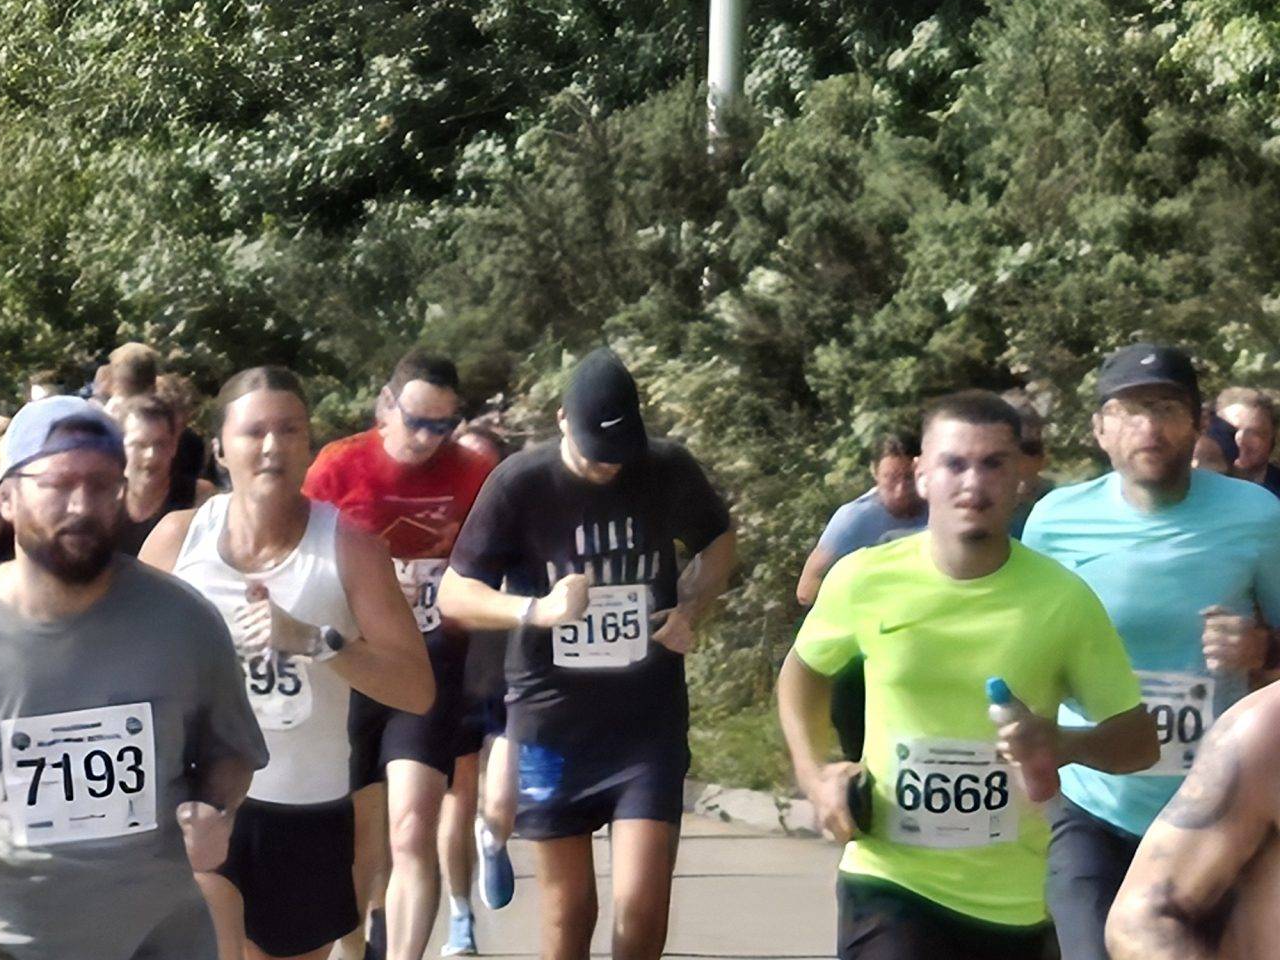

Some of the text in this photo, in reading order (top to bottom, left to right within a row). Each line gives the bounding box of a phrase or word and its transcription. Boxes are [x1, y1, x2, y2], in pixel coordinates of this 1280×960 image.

[560, 610, 641, 645] 5165
[246, 651, 303, 696] 95
[1149, 704, 1204, 745] 90
[16, 745, 146, 806] 7193
[896, 768, 1009, 814] 6668
